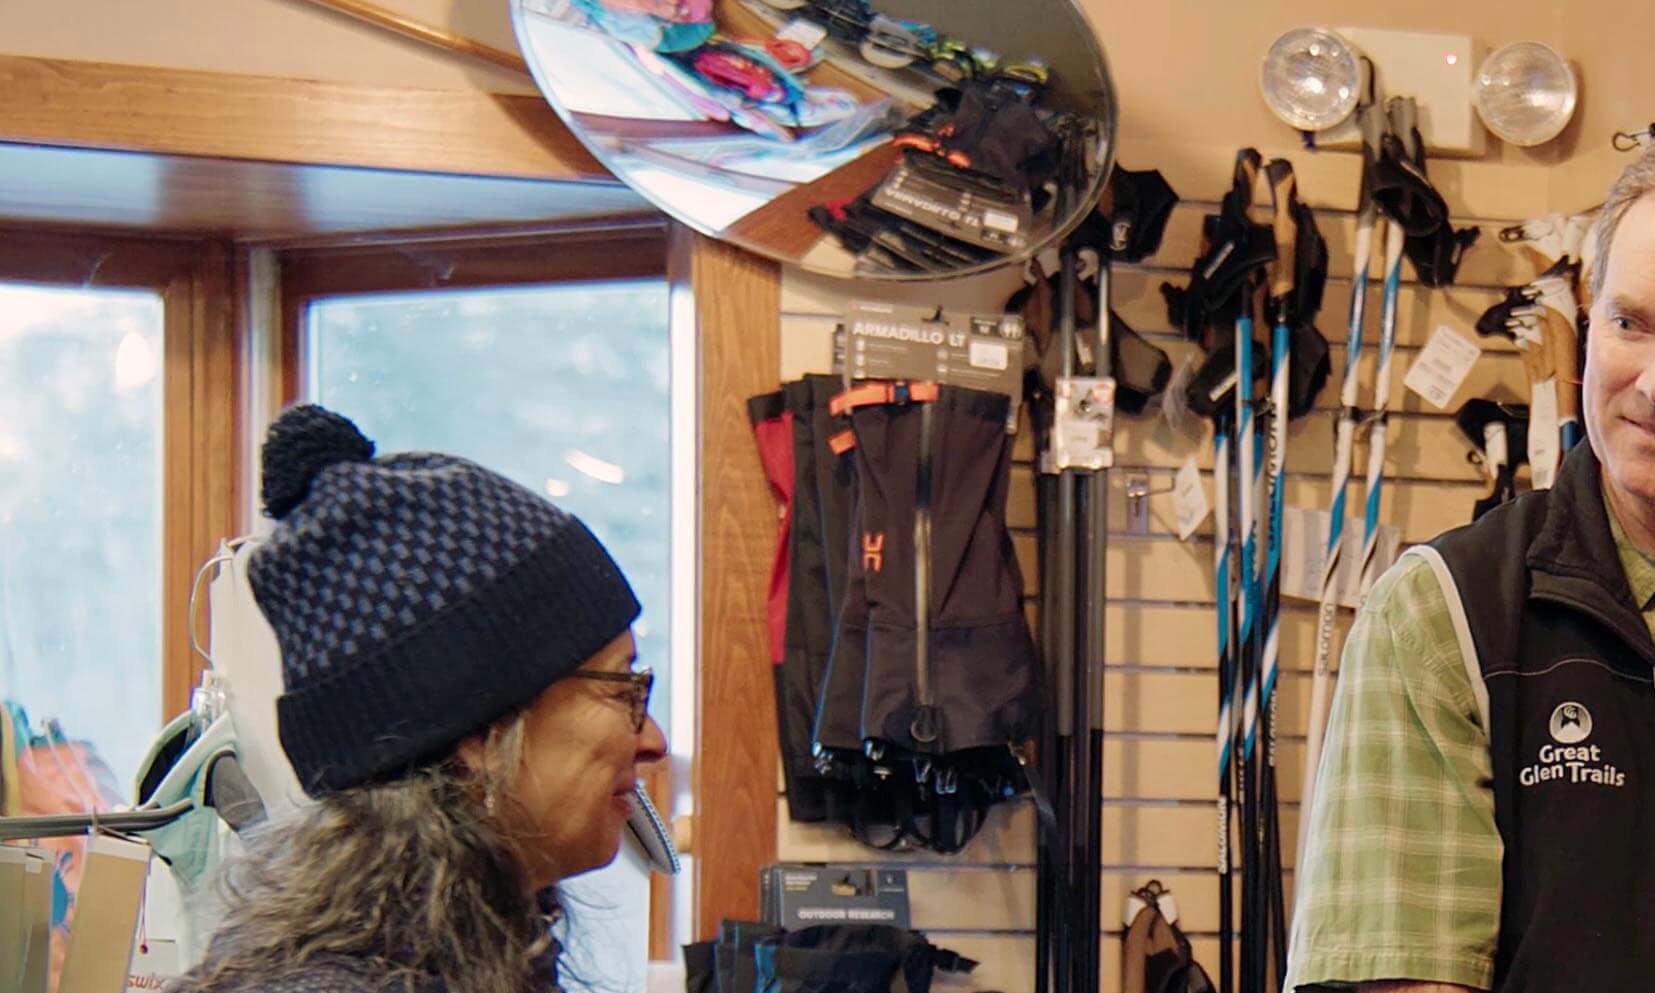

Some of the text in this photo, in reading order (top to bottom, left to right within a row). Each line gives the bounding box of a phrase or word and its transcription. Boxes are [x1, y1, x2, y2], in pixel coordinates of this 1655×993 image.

[853, 321, 944, 345] ARMADILLO
[949, 331, 967, 347] LT
[1539, 744, 1600, 763] Great
[1520, 762, 1625, 786] Glen Trails
[798, 908, 895, 920] OUTDOOR RESEARCH
